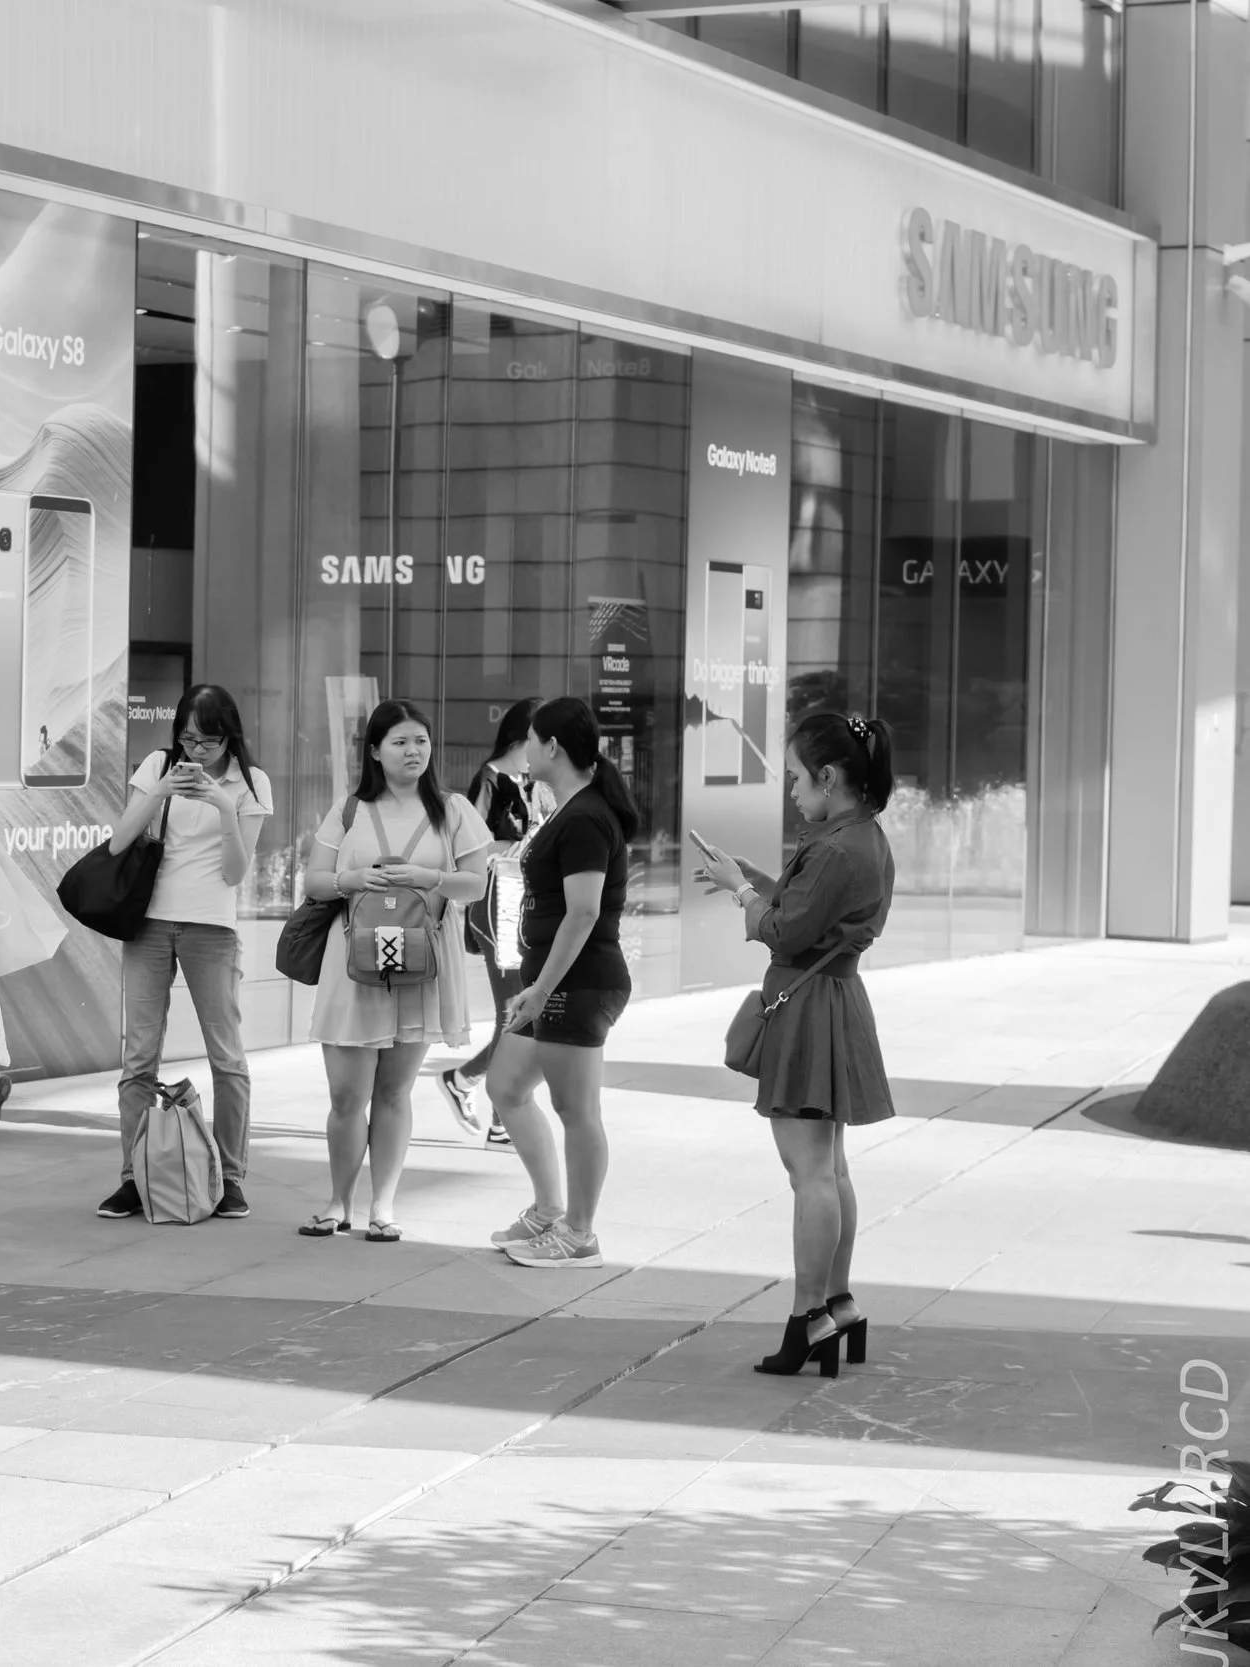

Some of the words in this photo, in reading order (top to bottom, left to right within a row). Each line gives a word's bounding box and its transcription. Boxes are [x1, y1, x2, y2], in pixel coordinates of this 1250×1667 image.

[901, 206, 1119, 370] SAMSUNG
[62, 335, 85, 366] S8
[707, 443, 746, 476] Galaxy
[745, 449, 777, 476] Note8
[321, 555, 485, 585] SAMSNG
[903, 559, 1010, 584] GAAXY
[693, 658, 708, 682] Do
[710, 658, 746, 691] bigger
[747, 659, 780, 692] things
[4, 827, 49, 856] your
[53, 821, 114, 860] phone
